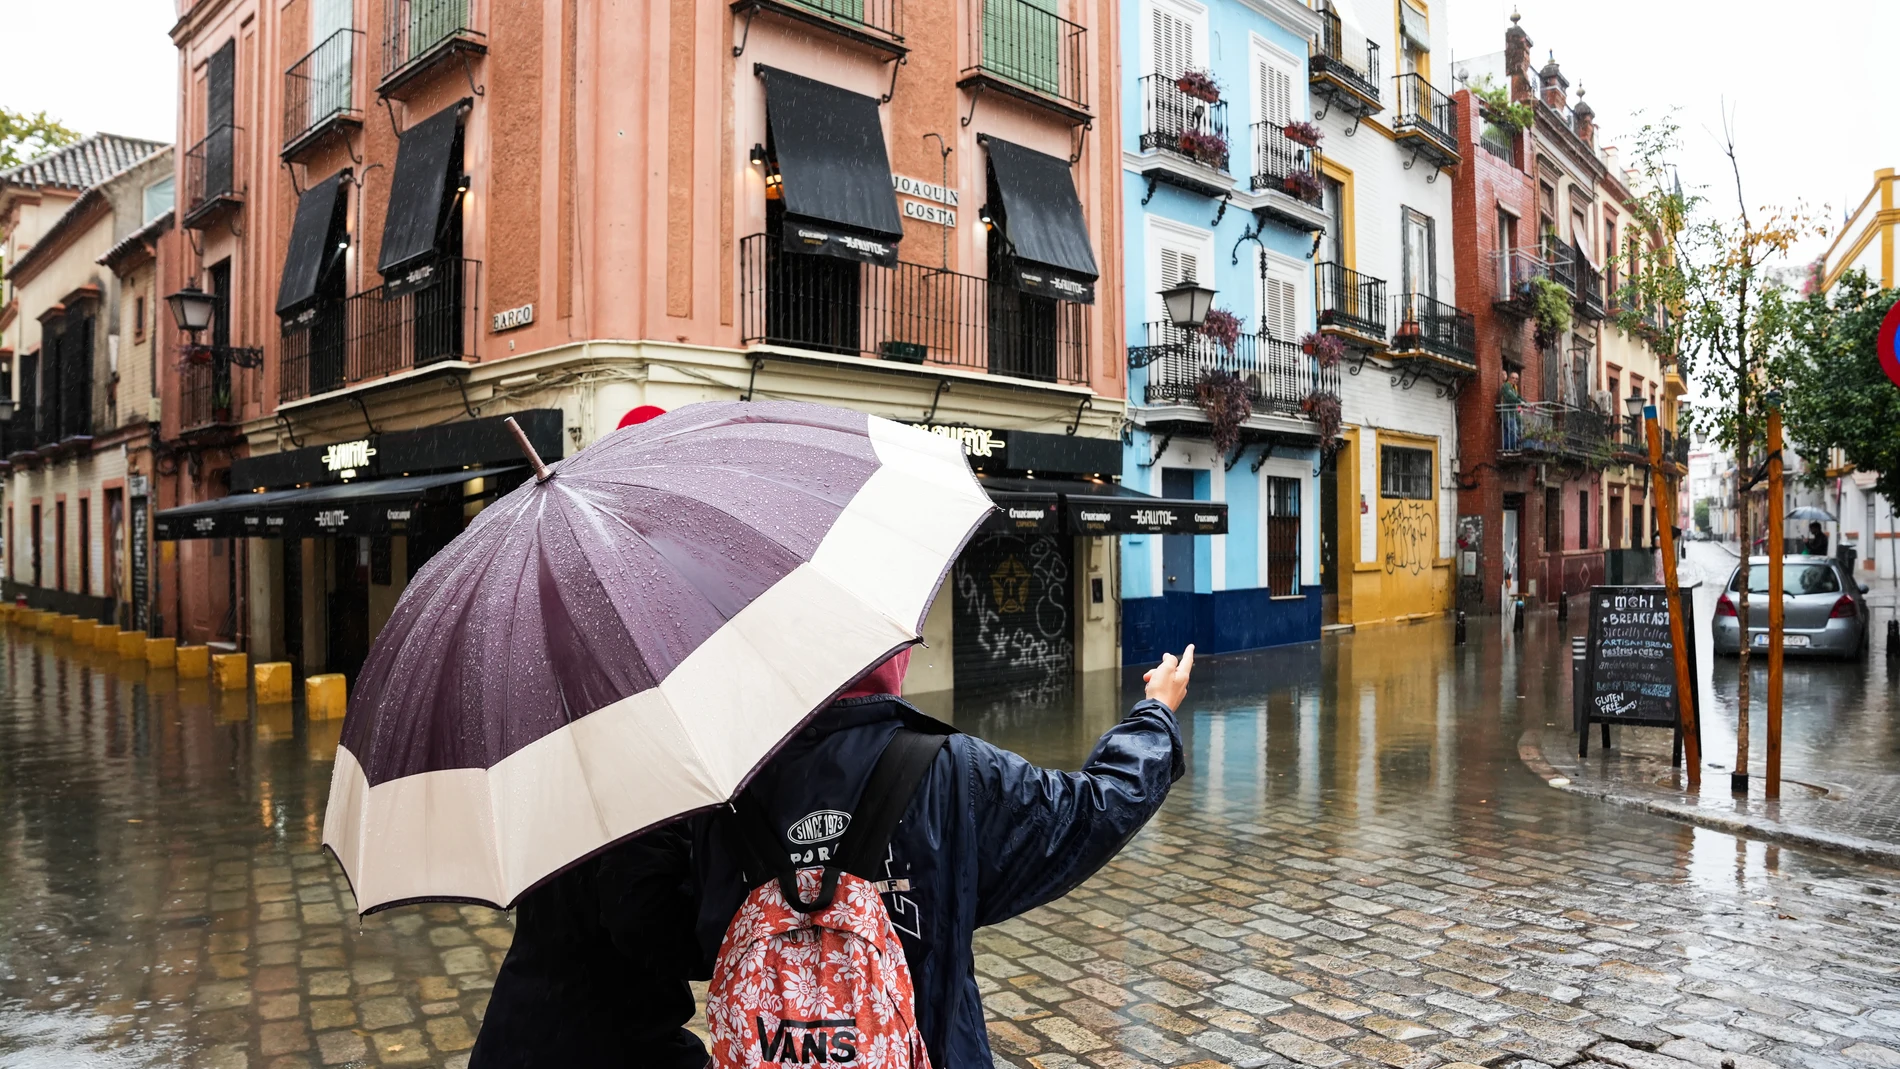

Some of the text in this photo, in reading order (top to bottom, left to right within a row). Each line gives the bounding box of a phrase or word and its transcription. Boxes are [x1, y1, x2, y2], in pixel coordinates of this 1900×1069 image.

[906, 202, 954, 226] COSTA
[494, 306, 530, 330] BARCO
[1009, 508, 1044, 520] Cruzcampo
[1080, 510, 1111, 522] Cruzcampo
[1610, 612, 1670, 626] BREAKFAST
[1645, 640, 1672, 649] BREAD
[1594, 692, 1624, 706] GLUTEN
[1600, 702, 1622, 714] FREE
[796, 814, 844, 840] SINCE 1973
[756, 1016, 856, 1064] VANS
